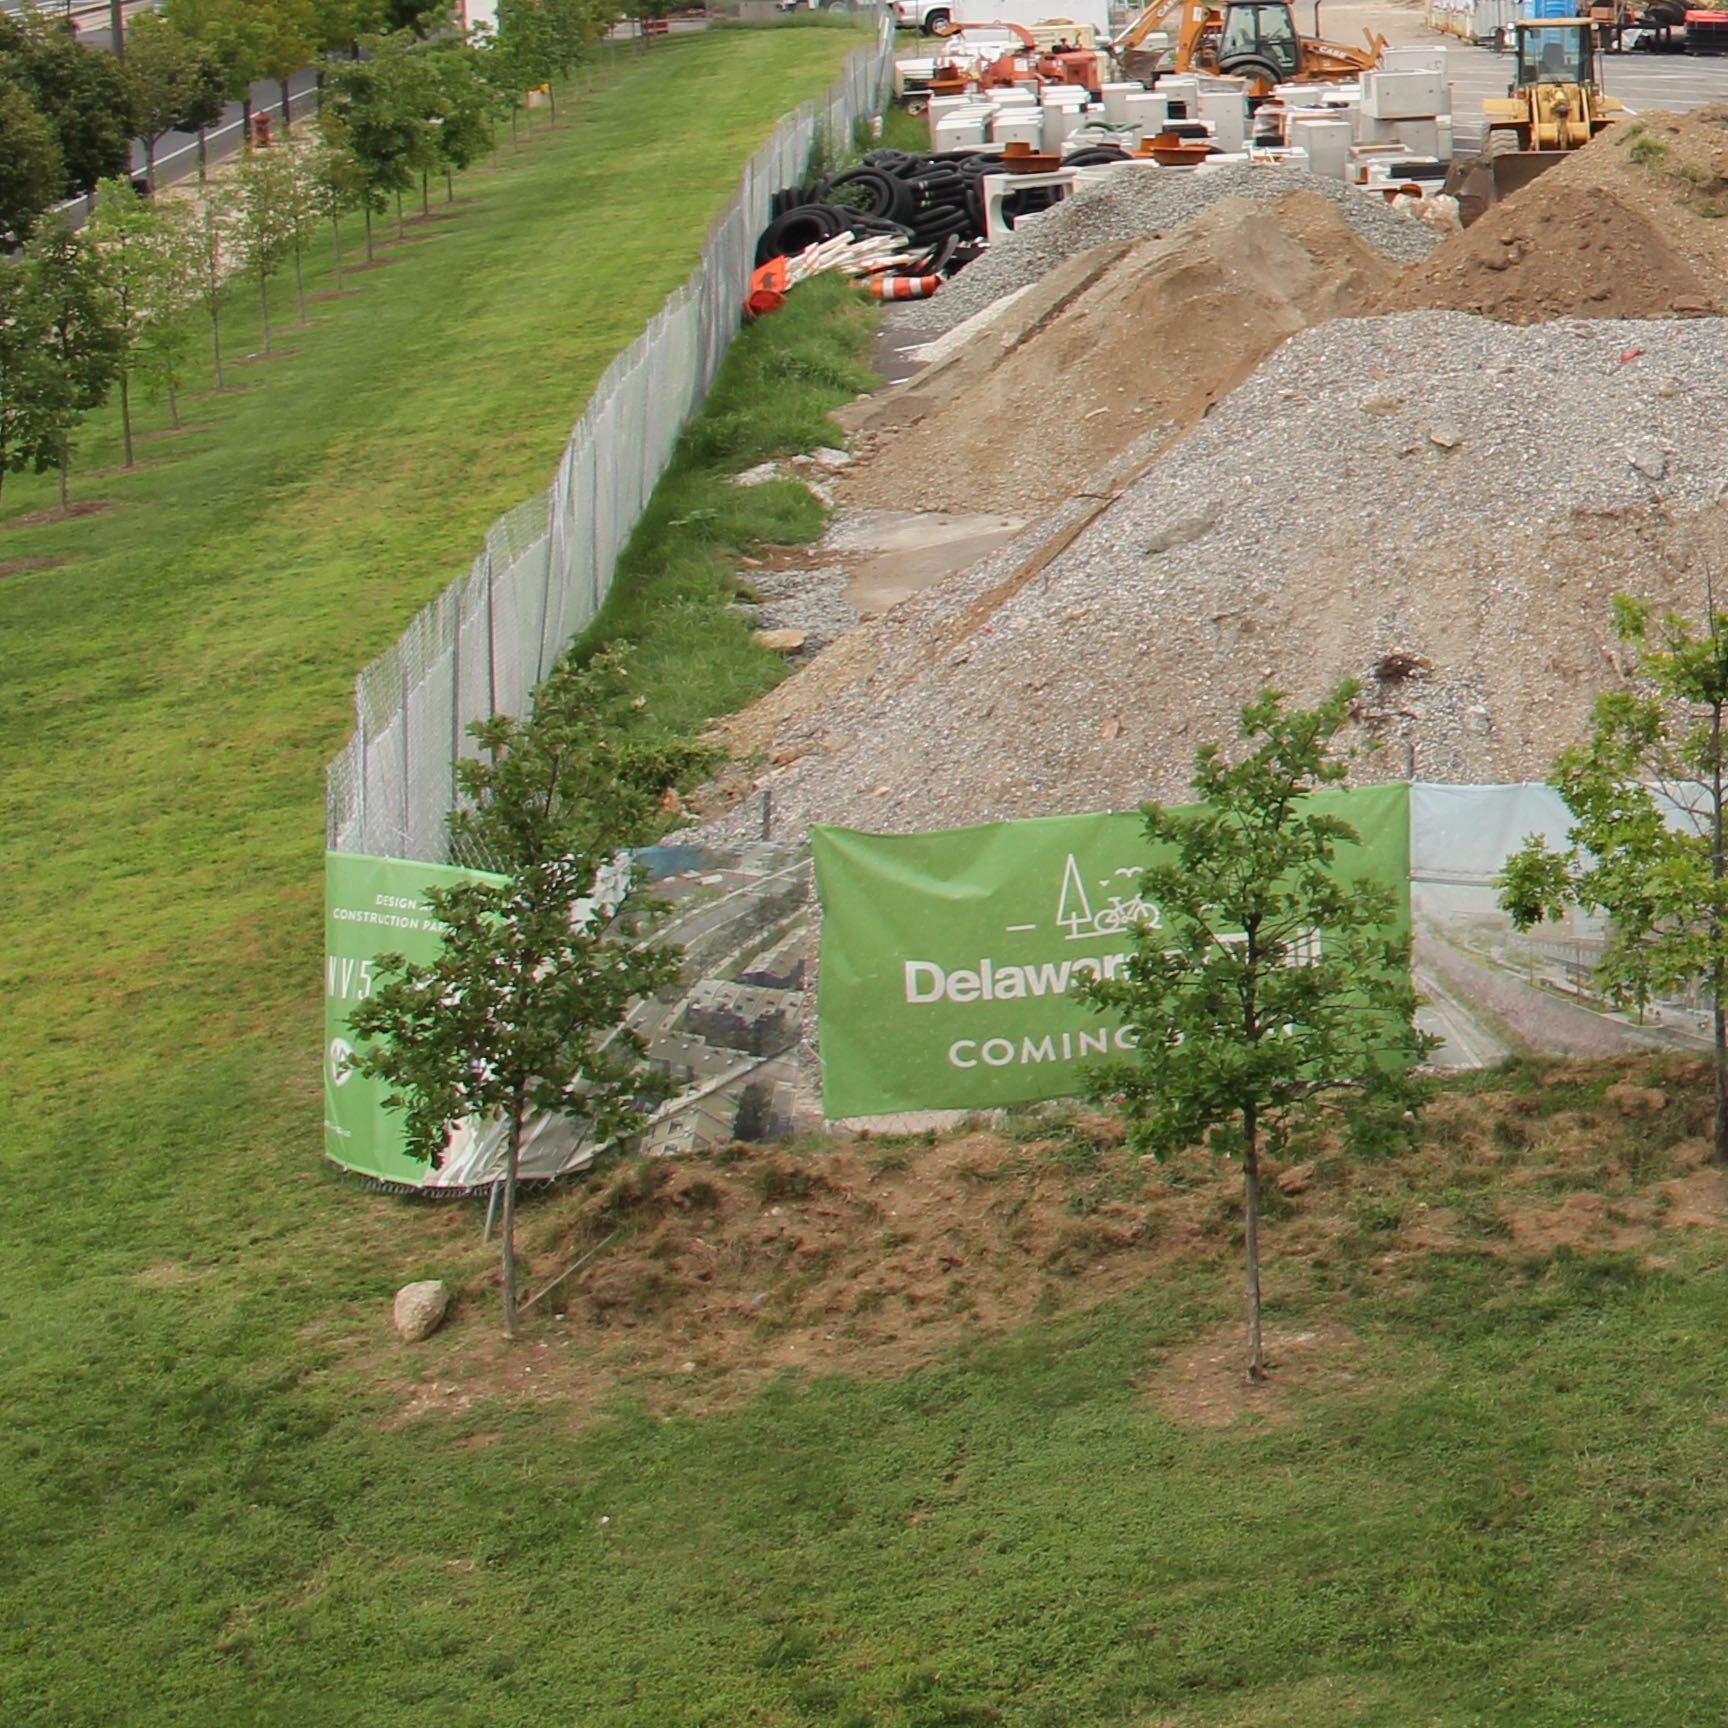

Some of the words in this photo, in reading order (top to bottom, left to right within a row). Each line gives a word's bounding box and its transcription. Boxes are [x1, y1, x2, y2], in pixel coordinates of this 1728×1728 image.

[1319, 45, 1348, 60] CASE
[376, 893, 417, 910] DESIGN
[333, 908, 418, 930] CONSTRUCTION
[904, 950, 1138, 1004] Delawar
